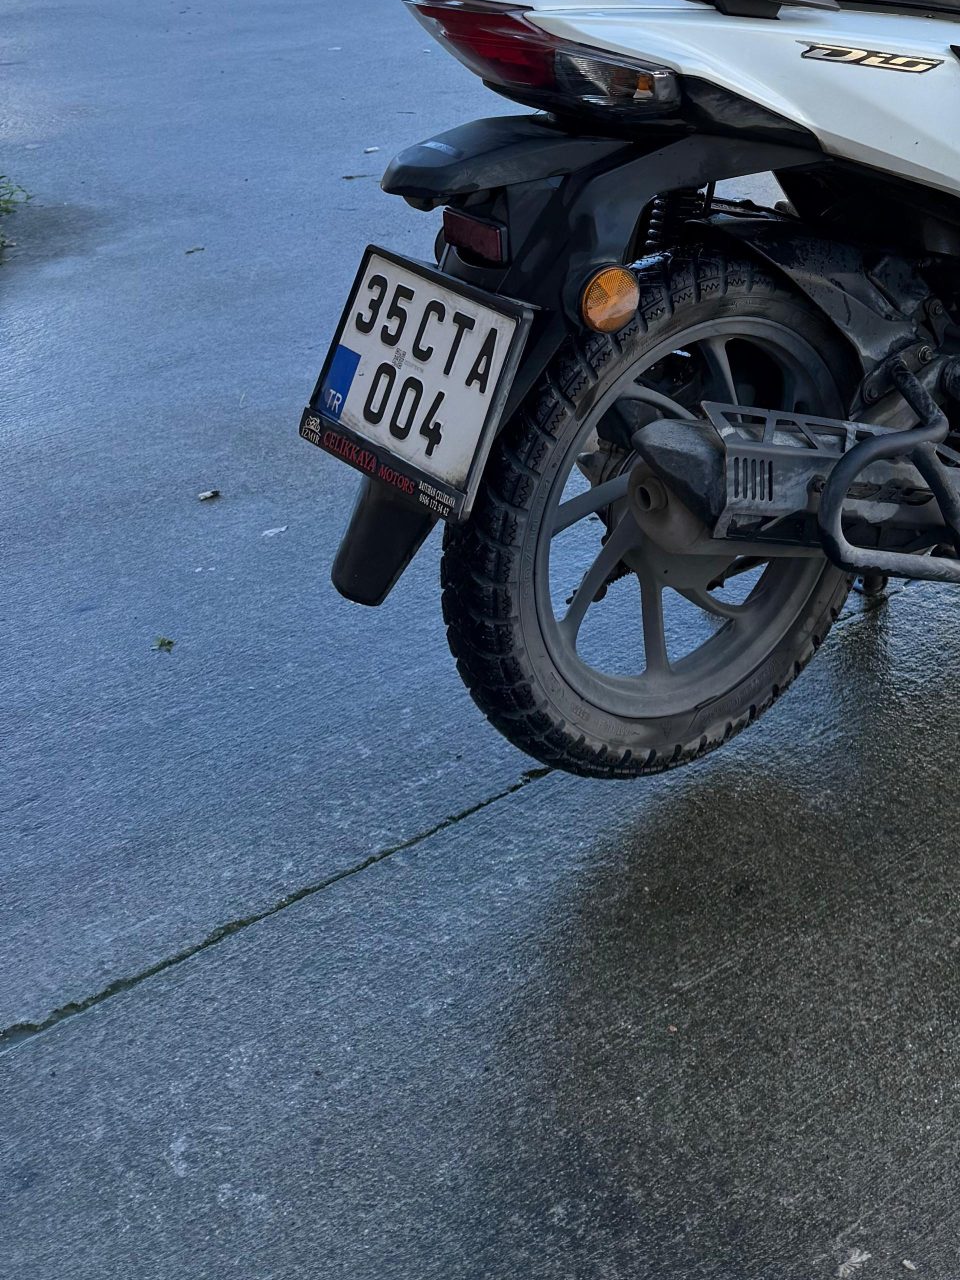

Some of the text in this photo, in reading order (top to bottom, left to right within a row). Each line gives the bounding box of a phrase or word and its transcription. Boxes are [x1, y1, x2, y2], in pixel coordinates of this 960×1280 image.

[326, 388, 342, 414] TR
[362, 362, 446, 457] 004
[378, 463, 415, 495] MOTORS
